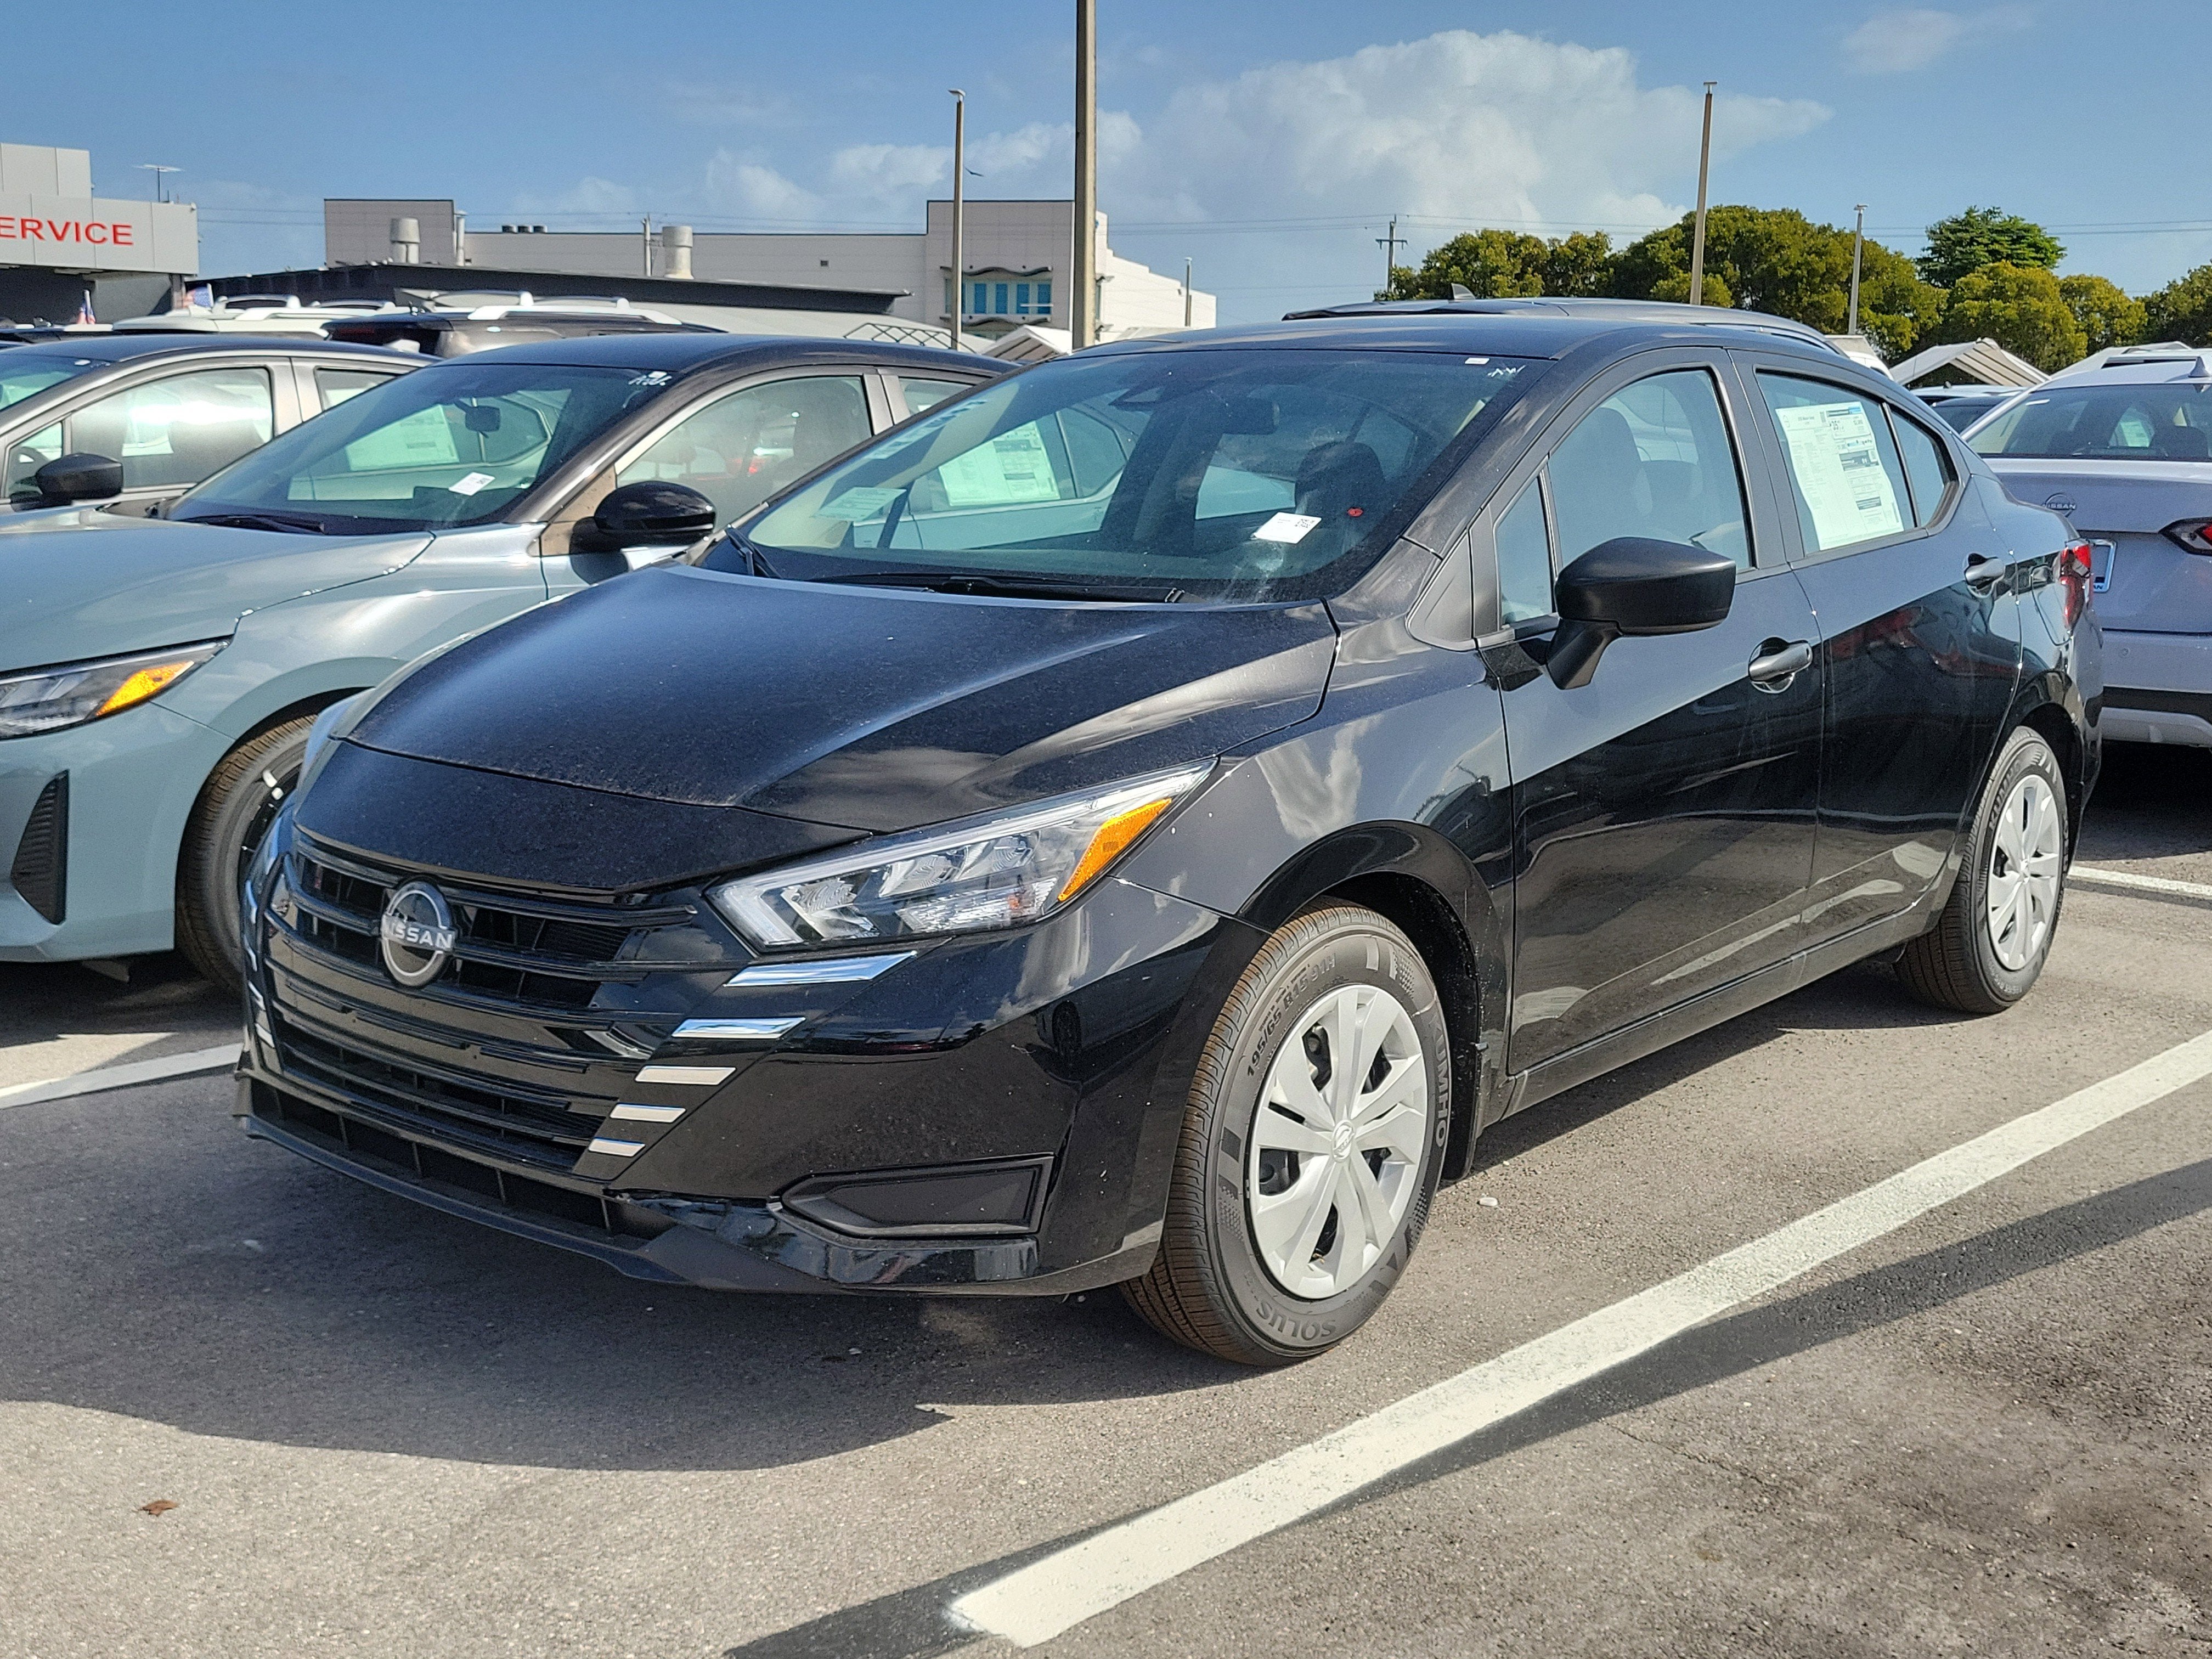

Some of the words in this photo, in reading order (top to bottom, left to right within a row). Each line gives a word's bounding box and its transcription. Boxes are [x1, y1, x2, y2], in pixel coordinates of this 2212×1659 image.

[1247, 1008, 1282, 1077] 195/65
[1283, 975, 1308, 1012] R15
[1311, 952, 1336, 982] 91H
[1429, 1014, 1449, 1148] KUMHO
[1256, 1302, 1336, 1341] SOLUS
